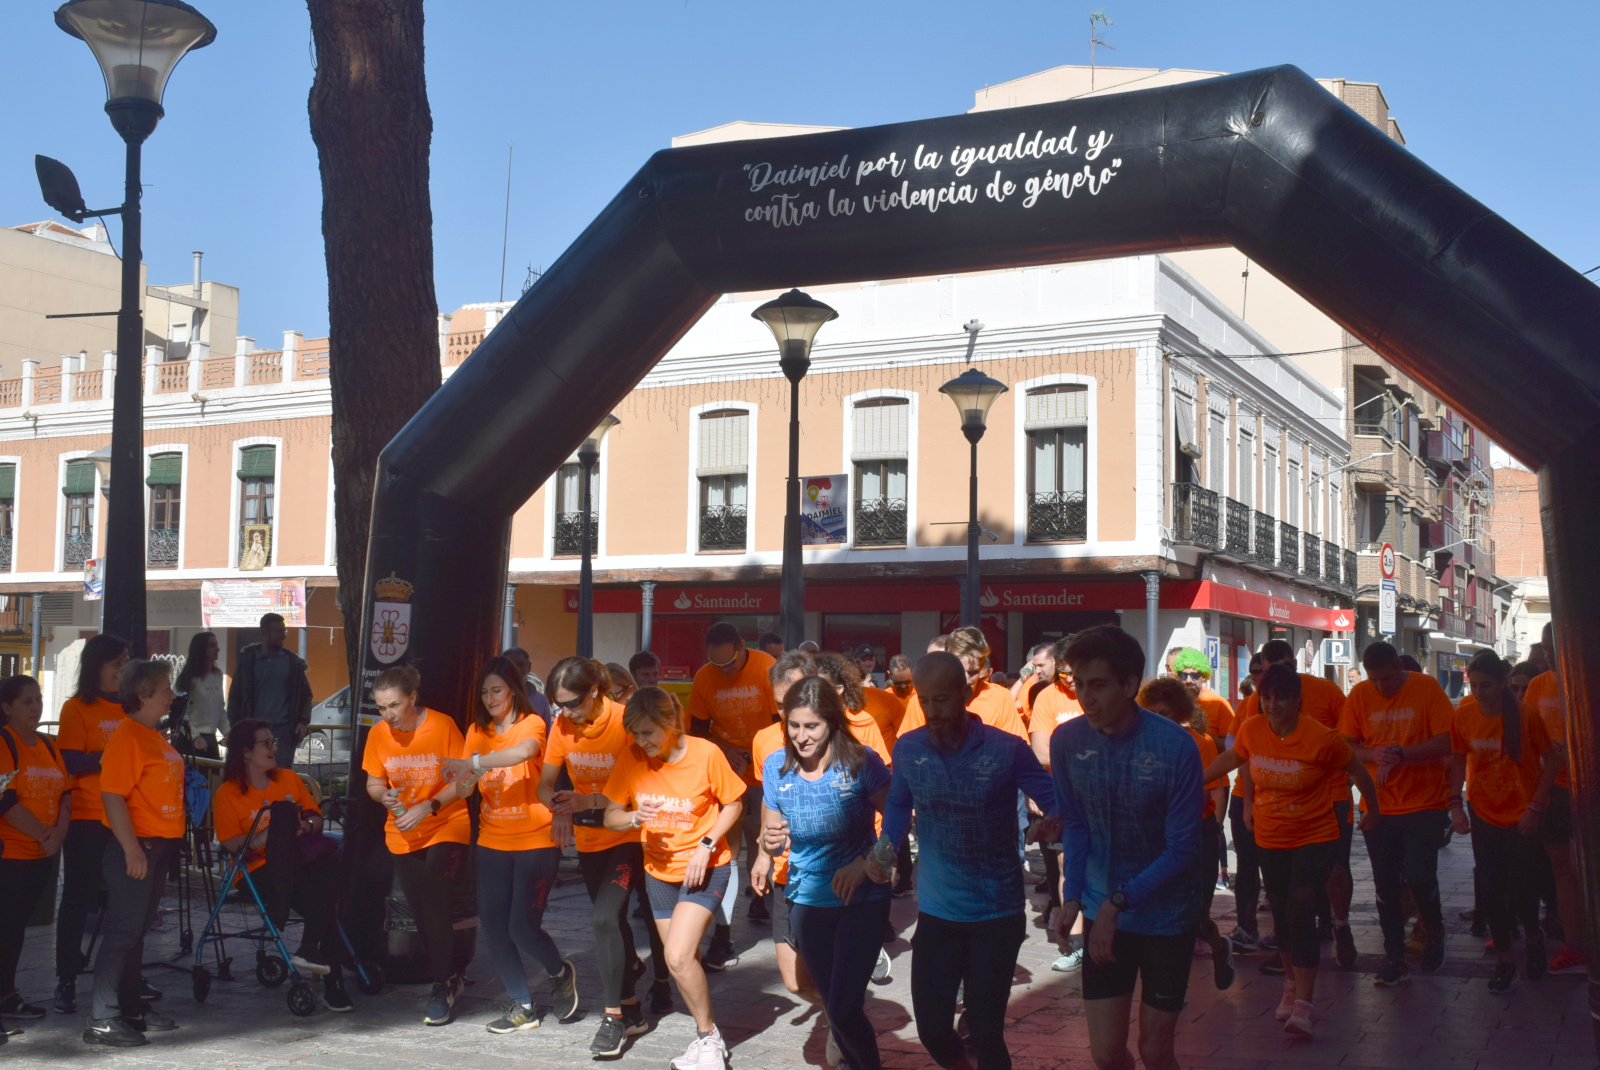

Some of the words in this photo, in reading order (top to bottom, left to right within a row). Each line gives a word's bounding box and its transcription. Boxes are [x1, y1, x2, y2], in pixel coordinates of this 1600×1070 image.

[855, 151, 906, 185] por
[914, 144, 944, 171] la
[950, 125, 1078, 176] igualdad
[1088, 129, 1114, 160] y
[744, 192, 820, 228] contra
[828, 189, 856, 217] la
[863, 180, 979, 213] violencia
[986, 171, 1017, 203] de
[807, 506, 843, 520] DAIMIEL
[694, 592, 762, 609] Santander
[1003, 588, 1084, 606] Santander
[1273, 602, 1290, 619] Santander
[1208, 640, 1217, 659] P
[1331, 641, 1344, 663] P
